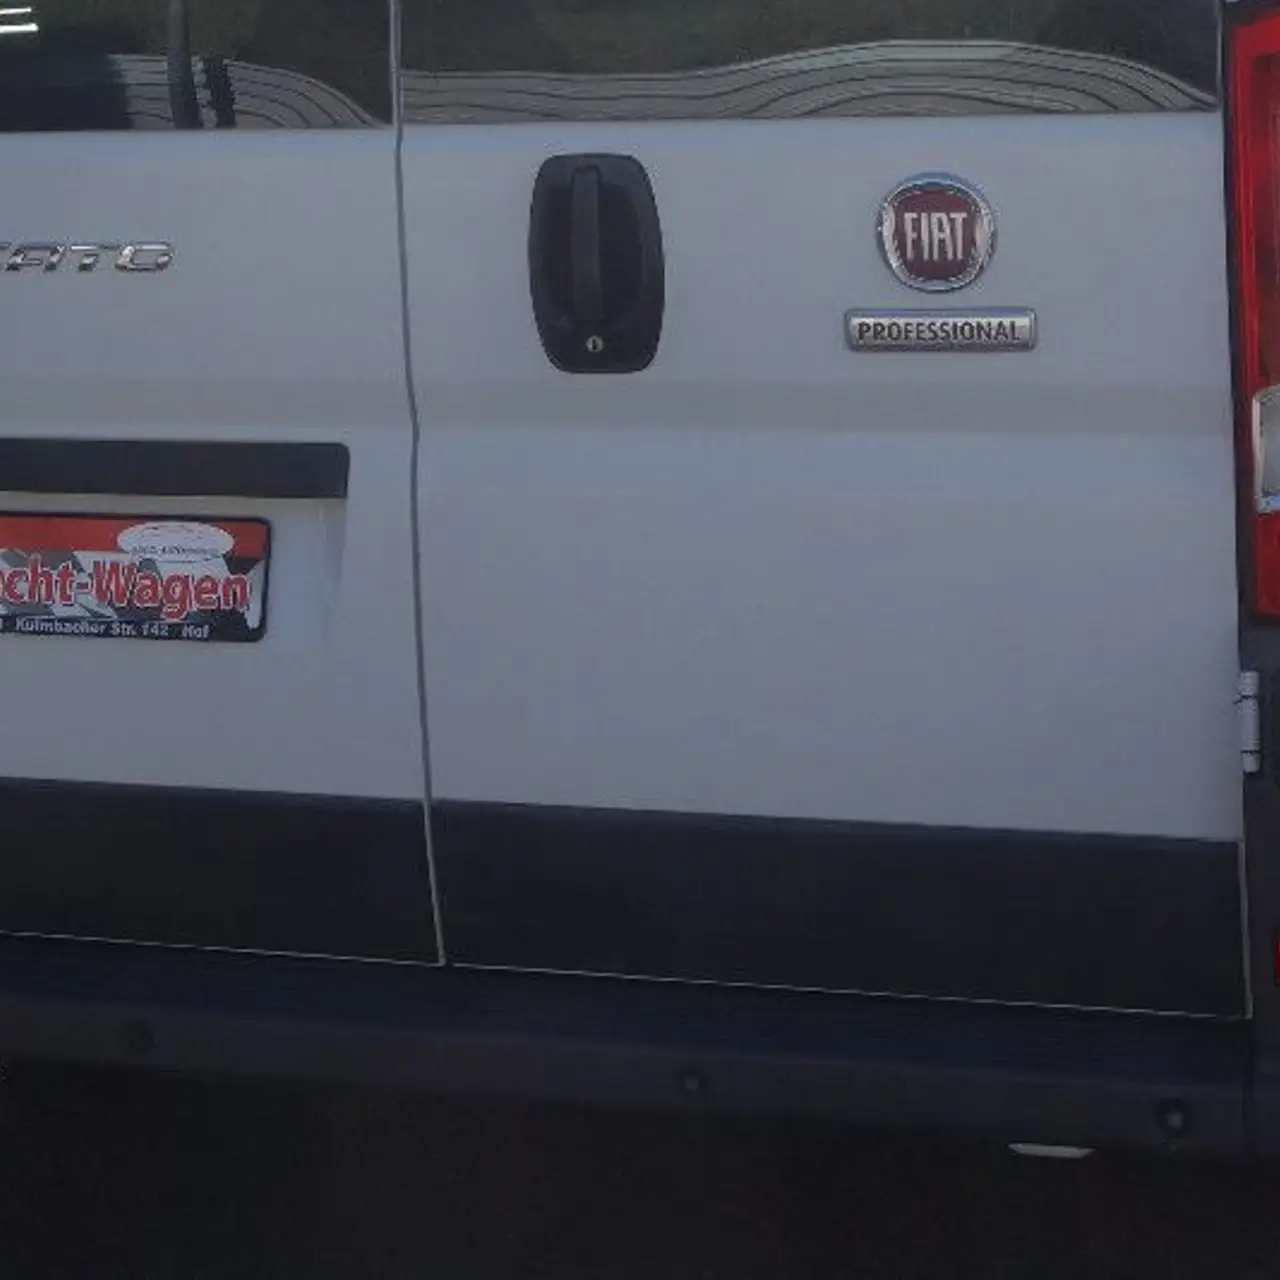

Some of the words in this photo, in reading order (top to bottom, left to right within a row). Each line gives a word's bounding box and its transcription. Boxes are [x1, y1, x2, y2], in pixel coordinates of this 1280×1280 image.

[903, 211, 968, 262] FIAT
[857, 320, 1022, 342] PROFESSIONAL
[15, 616, 107, 635] Kulmbacher
